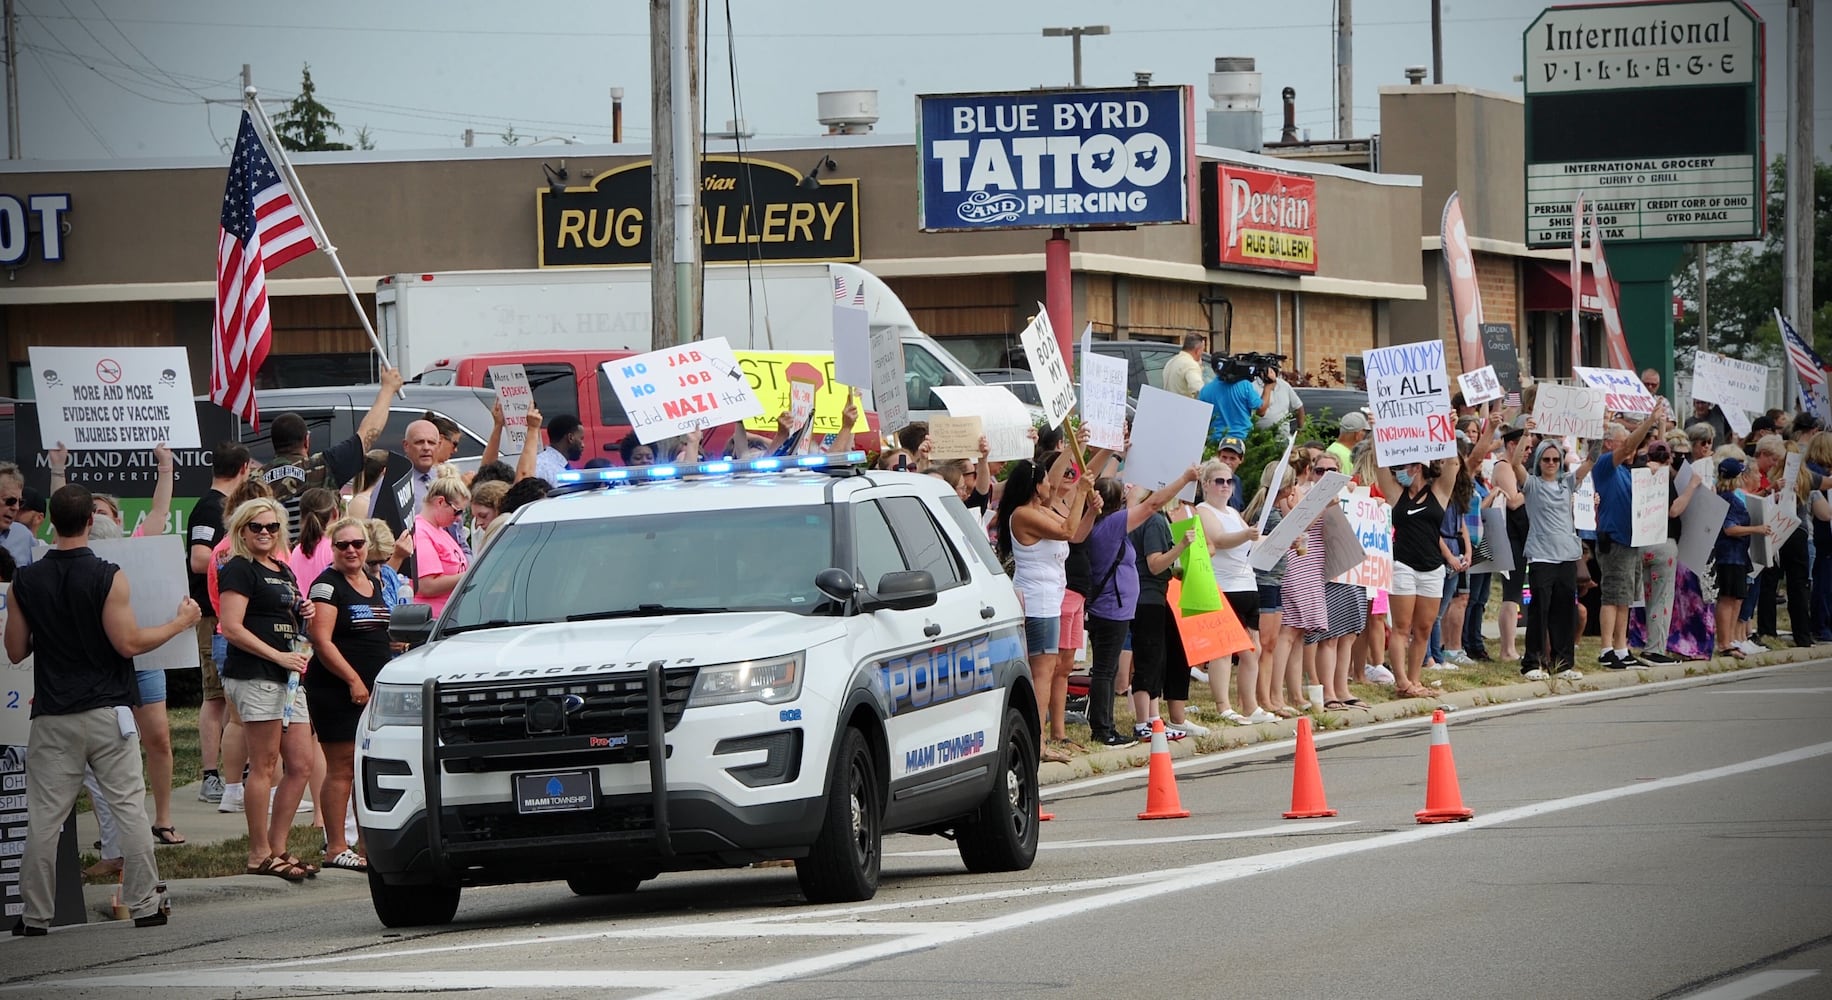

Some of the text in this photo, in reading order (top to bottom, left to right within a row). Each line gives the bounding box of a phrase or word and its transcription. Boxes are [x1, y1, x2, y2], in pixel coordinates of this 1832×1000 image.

[1545, 15, 1730, 51] International
[953, 101, 1149, 134] BLUE BYRD
[932, 132, 1171, 192] TATTOO
[1564, 158, 1716, 173] INTERNATIONAL GROCERY
[1600, 175, 1633, 185] CURRY
[1651, 173, 1680, 183] GRILL
[1028, 191, 1147, 215] PIERCING
[1228, 178, 1310, 248] Persian
[1534, 201, 1636, 214] PERSIAN UG GALLERY
[1647, 200, 1678, 210] CREDIT
[1710, 199, 1721, 207] OF
[1724, 197, 1748, 207] OHIO
[557, 202, 845, 249] RUG LLERY
[1666, 212, 1728, 222] GYRO PALACE
[1246, 234, 1309, 258] RUG GALLERY
[1540, 231, 1551, 241] LD
[1606, 229, 1624, 239] TAX
[1037, 336, 1055, 366] BOD
[1366, 342, 1442, 378] AUTONOMY
[622, 351, 702, 378] NO JAB
[1048, 358, 1062, 384] MY
[1217, 362, 1224, 370] 7
[1249, 366, 1255, 374] 7
[73, 385, 153, 400] MORE AND MORE
[630, 371, 712, 398] NO JOB
[1377, 379, 1392, 397] for
[1400, 374, 1442, 395] ALL
[629, 389, 746, 428] I did NAZI that
[1052, 383, 1074, 419] CHOIC
[1543, 386, 1601, 412] STOP
[63, 406, 170, 421] EVIDENCE OF VACCINE
[754, 416, 840, 427] MATE
[74, 426, 170, 442] INJURIES EVERYDAY
[1376, 413, 1455, 443] INCLUDING RN
[36, 451, 213, 468] MDLAND ATLNTIC
[71, 472, 180, 481] PROPERTIS
[889, 636, 994, 714] POLICE
[7, 690, 19, 708] 2
[905, 730, 985, 774] MIAMI TOWNSHIP
[525, 795, 587, 806] MIAMI TOWNSHIP
